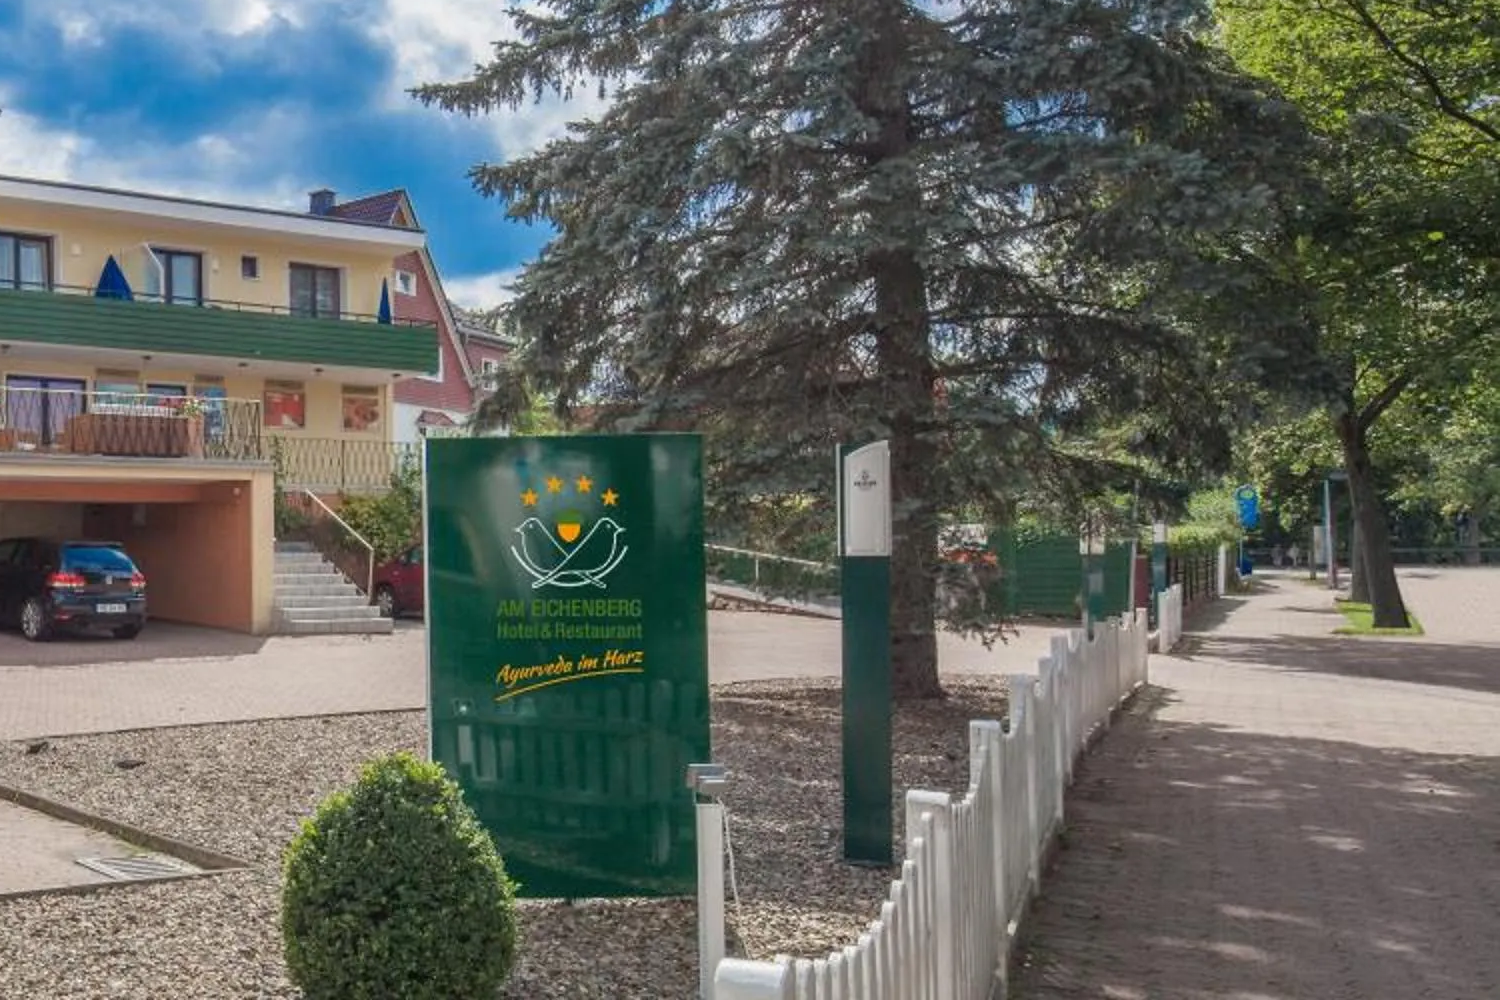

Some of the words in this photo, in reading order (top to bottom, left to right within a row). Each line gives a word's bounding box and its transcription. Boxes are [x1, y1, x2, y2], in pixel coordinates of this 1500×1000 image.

[497, 599, 525, 617] AM
[530, 599, 643, 617] EICHENBERG
[555, 621, 643, 640] Restaurant
[496, 654, 573, 688] Ayurveda
[576, 654, 599, 672] im
[602, 649, 645, 669] Harz
